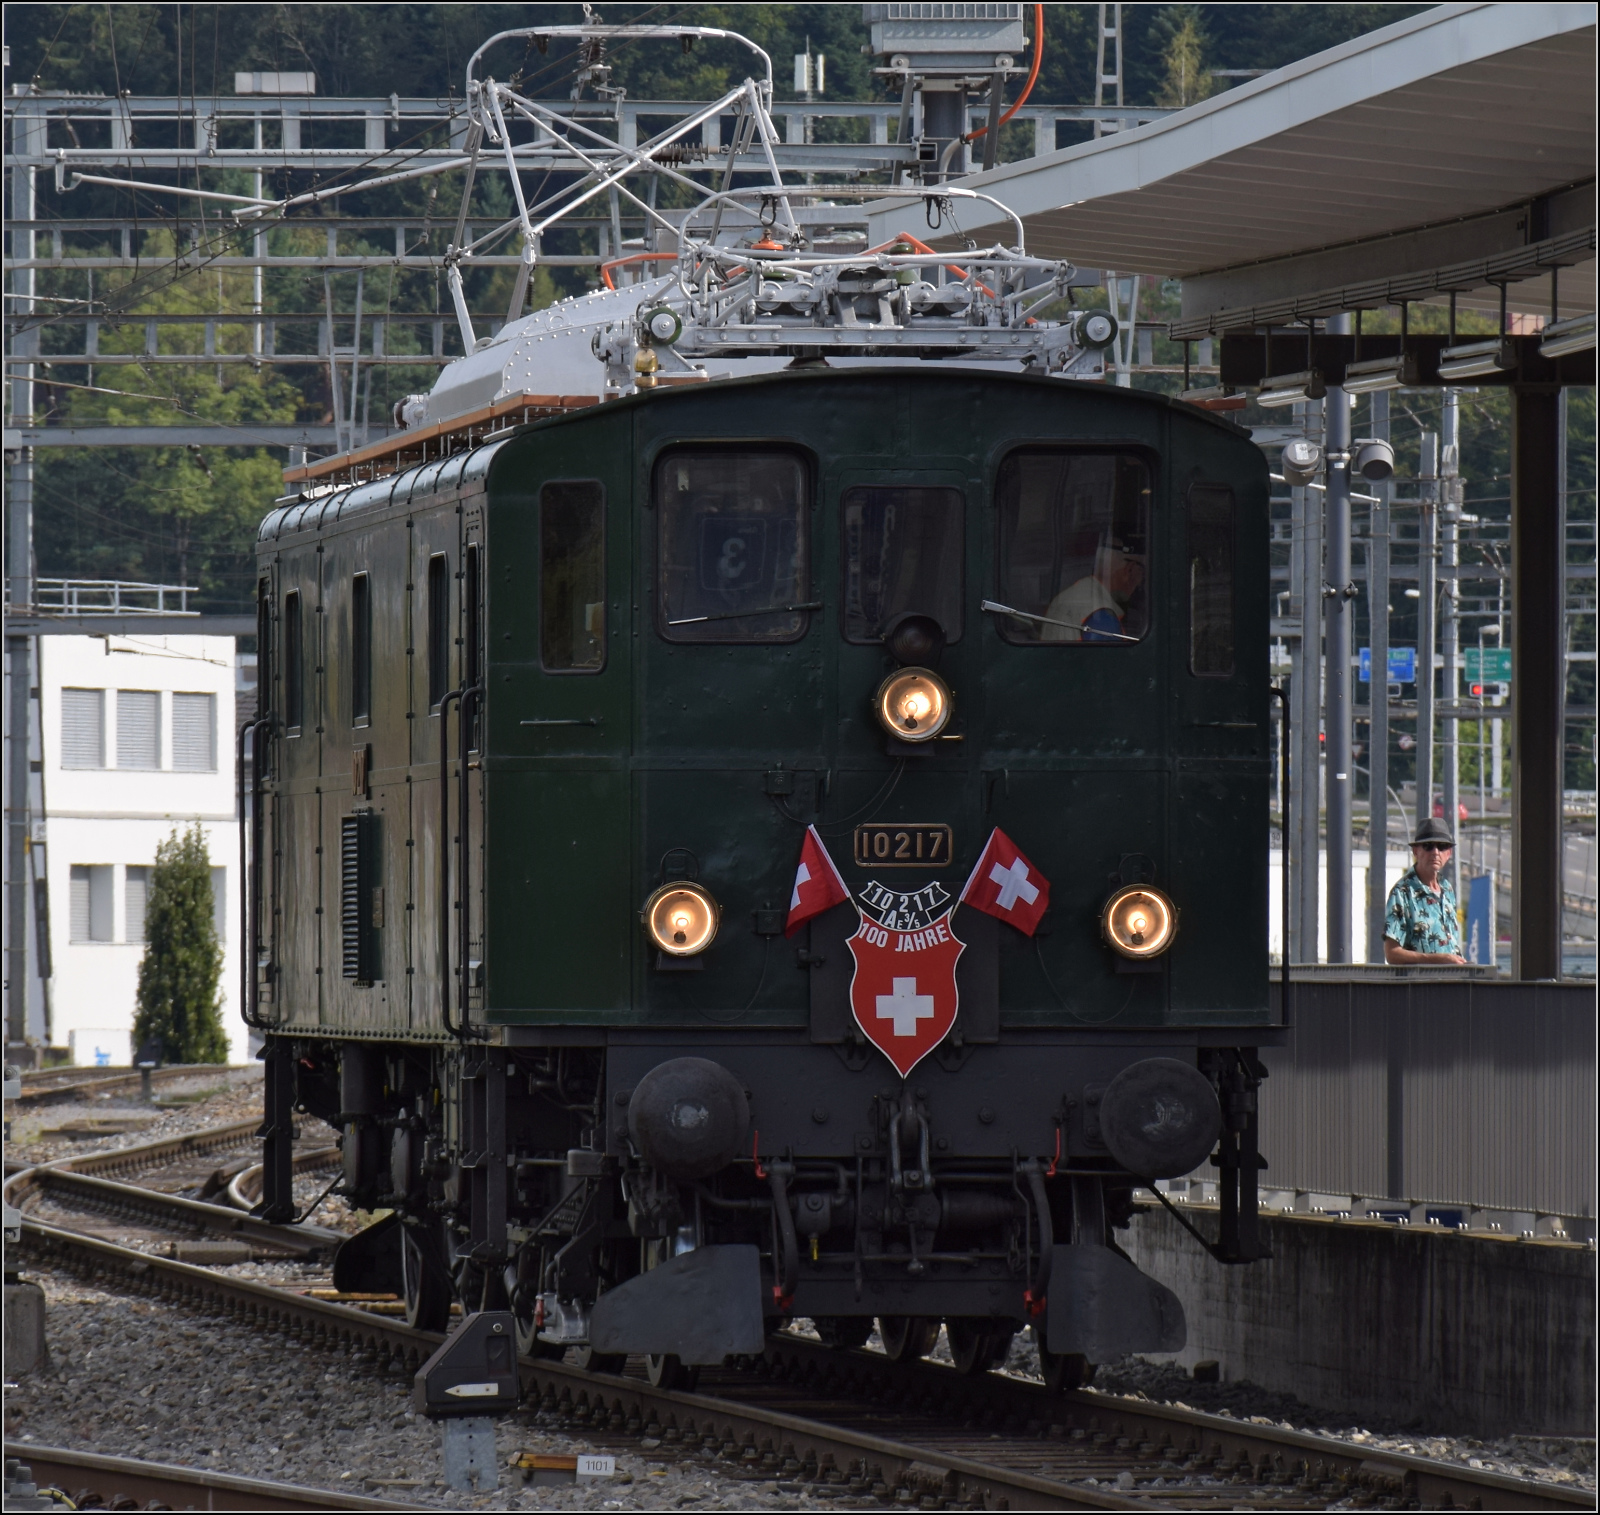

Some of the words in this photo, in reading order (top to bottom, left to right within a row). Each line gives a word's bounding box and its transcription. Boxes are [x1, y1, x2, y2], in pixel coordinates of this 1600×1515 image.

[862, 832, 944, 858] 10217
[858, 922, 889, 948] 100
[894, 923, 950, 953] JAHRE
[585, 1460, 608, 1472] 1101
